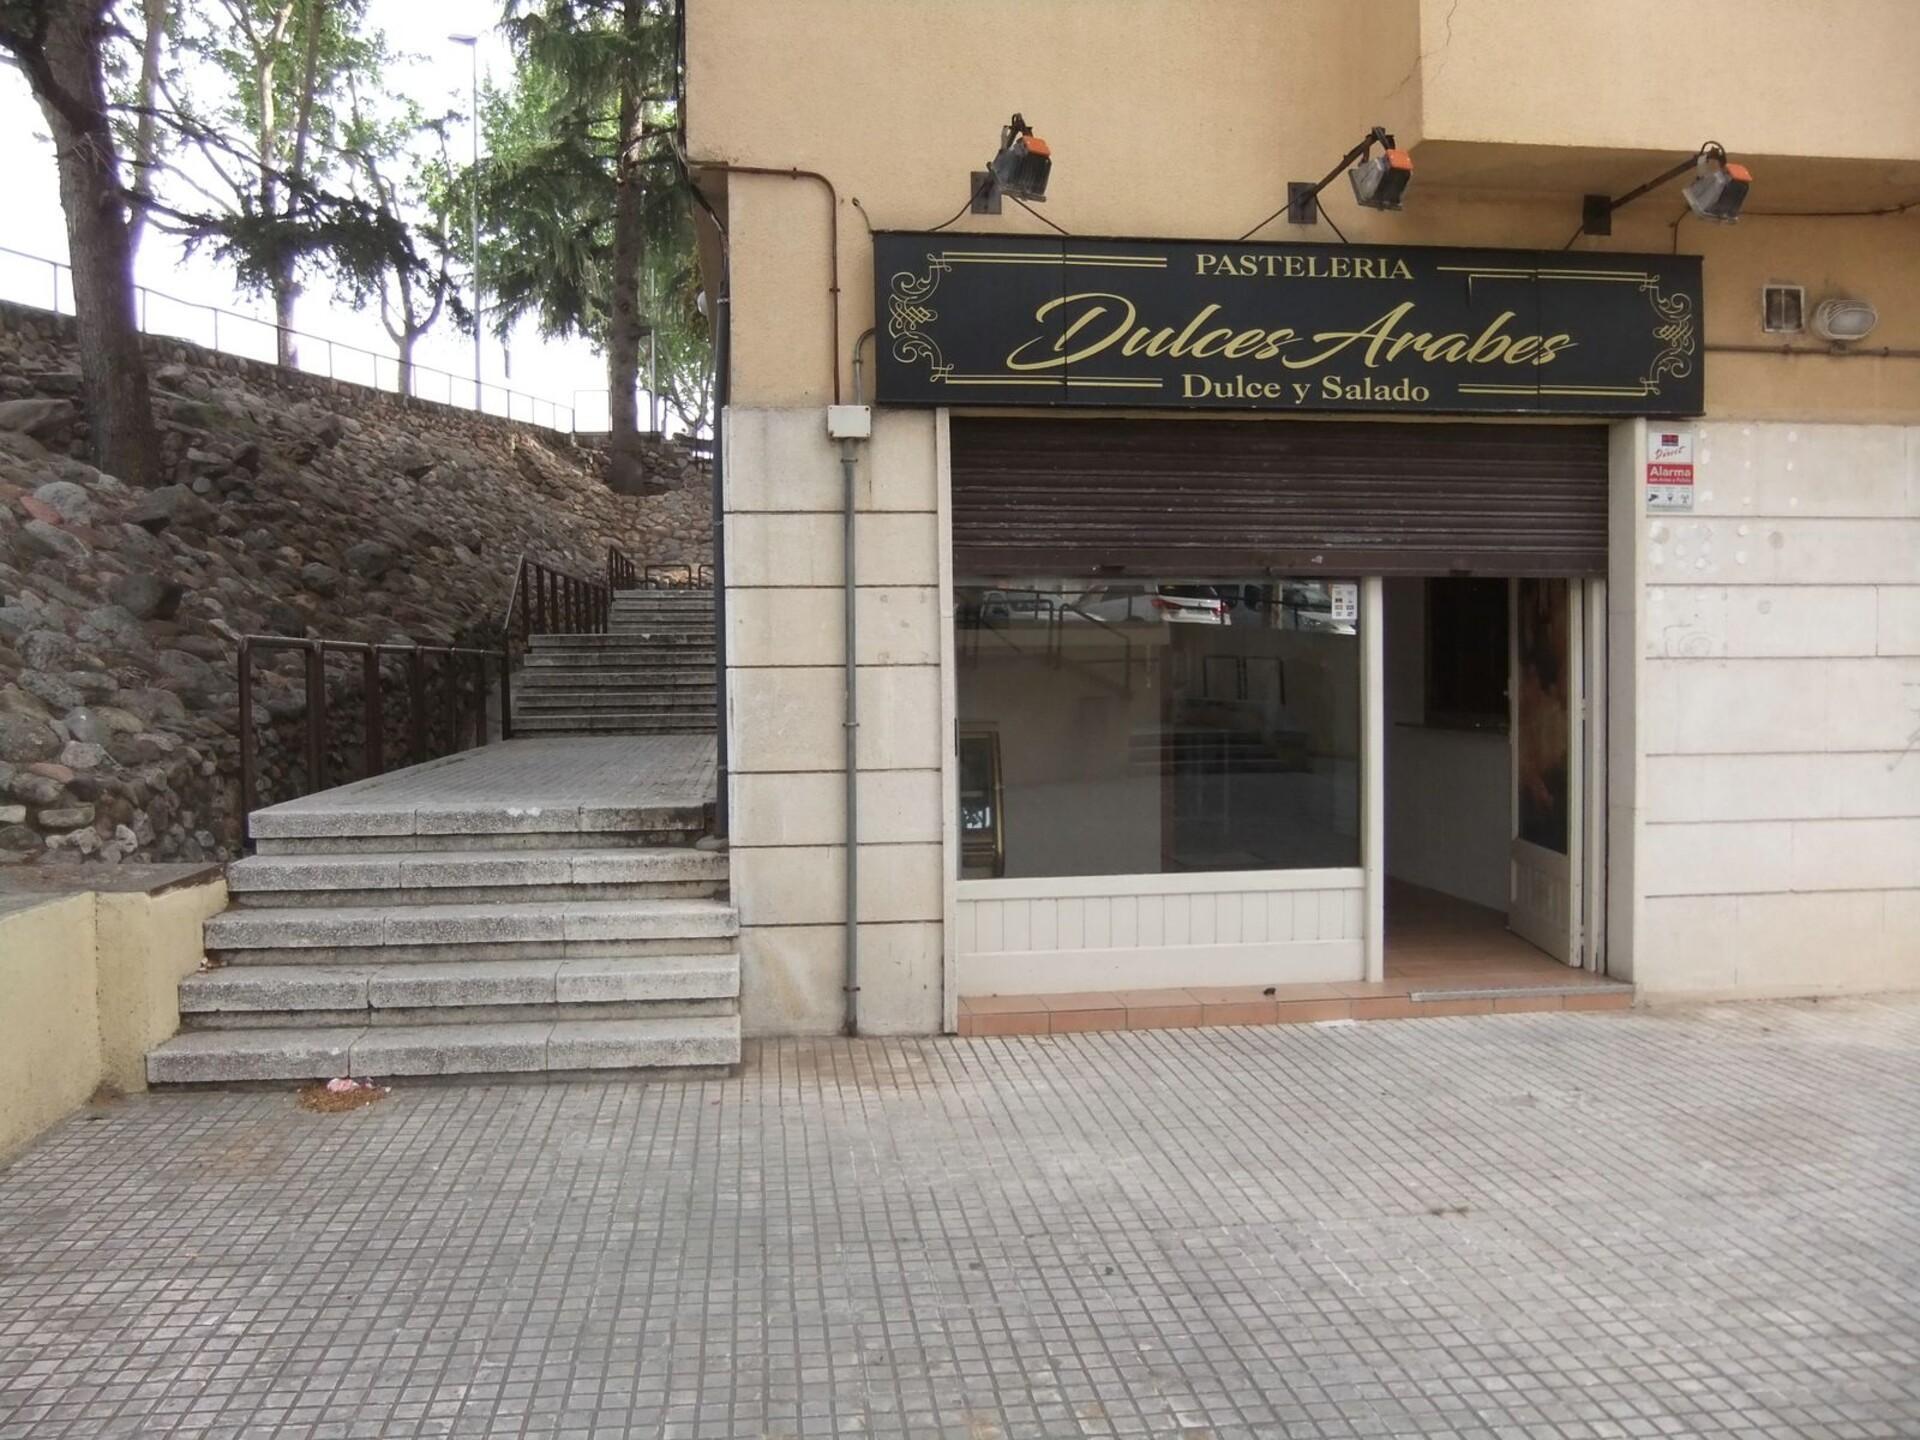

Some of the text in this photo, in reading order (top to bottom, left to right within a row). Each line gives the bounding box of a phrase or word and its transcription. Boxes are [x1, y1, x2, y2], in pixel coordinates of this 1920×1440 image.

[1195, 253, 1414, 280] PASTELERIA
[1006, 292, 1578, 371] Dulces Arabes
[1184, 374, 1430, 404] Dulce y Salado
[1650, 466, 1691, 477] Alarma
